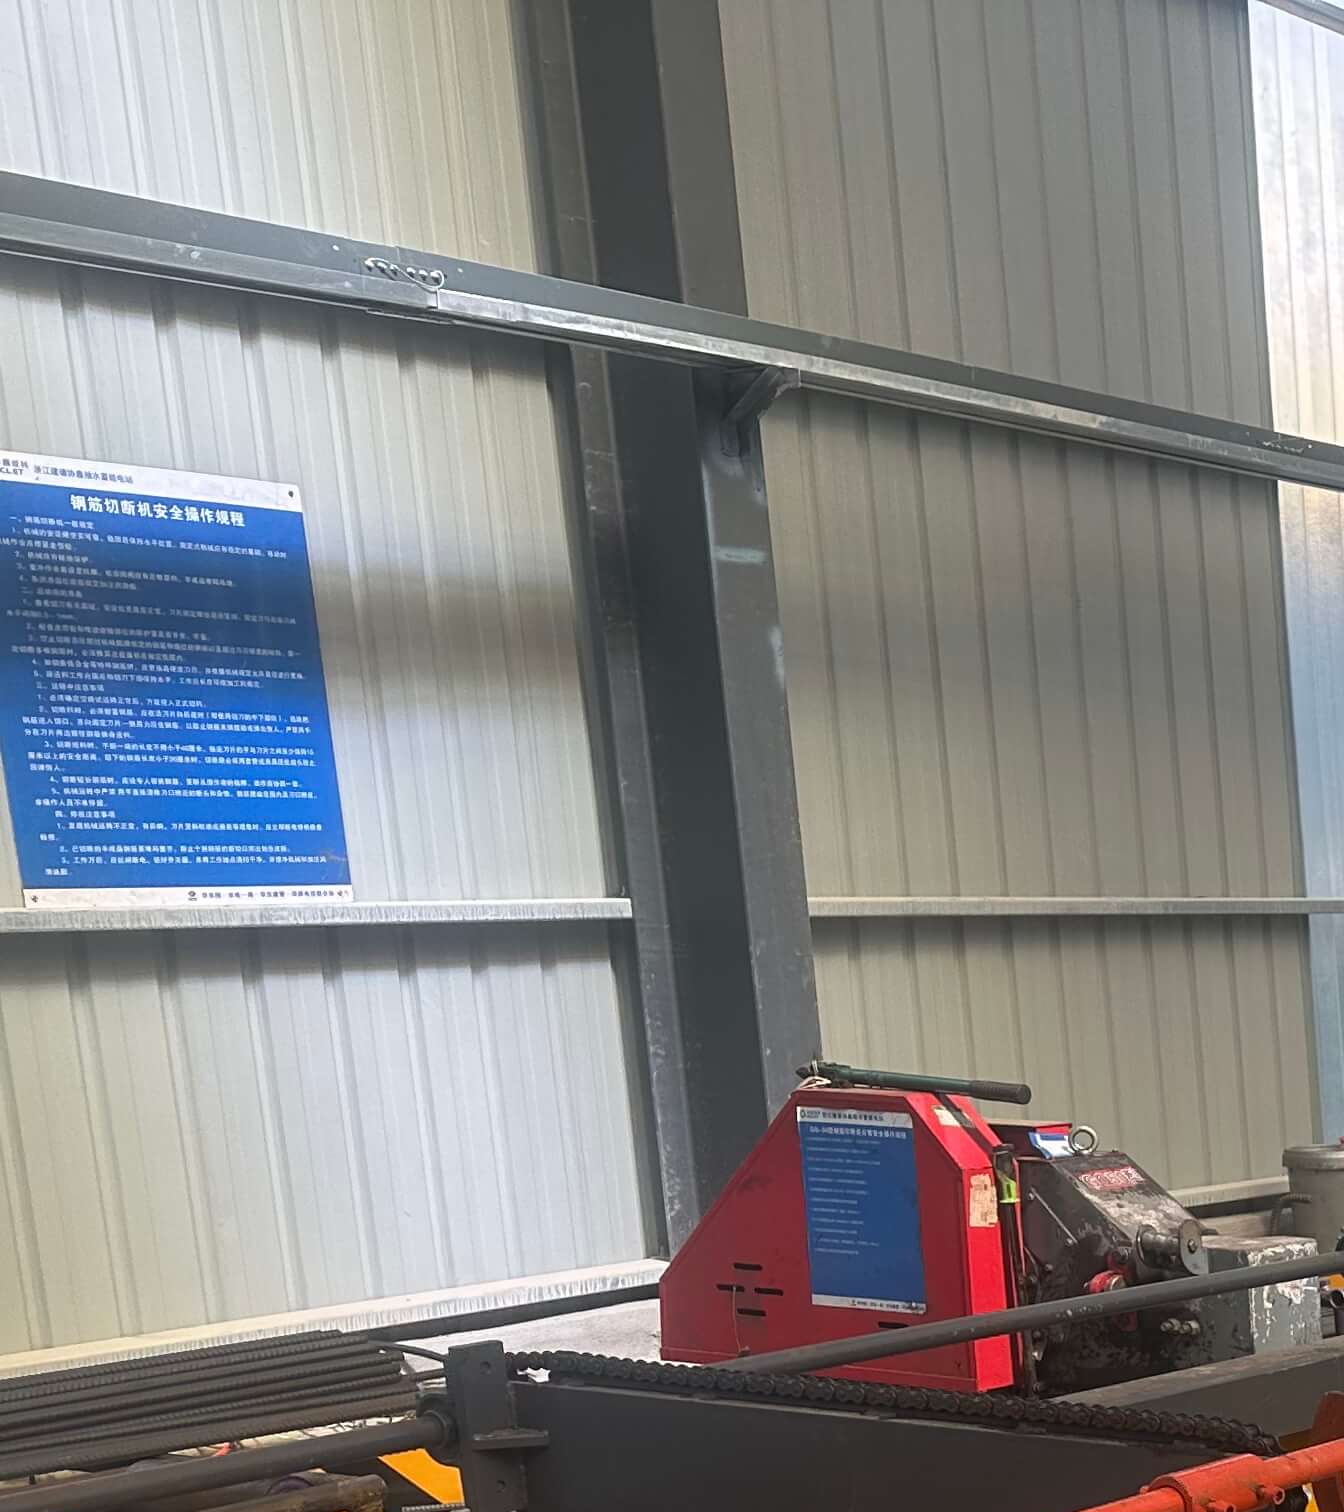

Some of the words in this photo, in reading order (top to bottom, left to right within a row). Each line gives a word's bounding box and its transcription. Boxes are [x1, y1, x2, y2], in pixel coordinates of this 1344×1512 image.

[70, 494, 246, 527] 钢筋切断机安全操作规程
